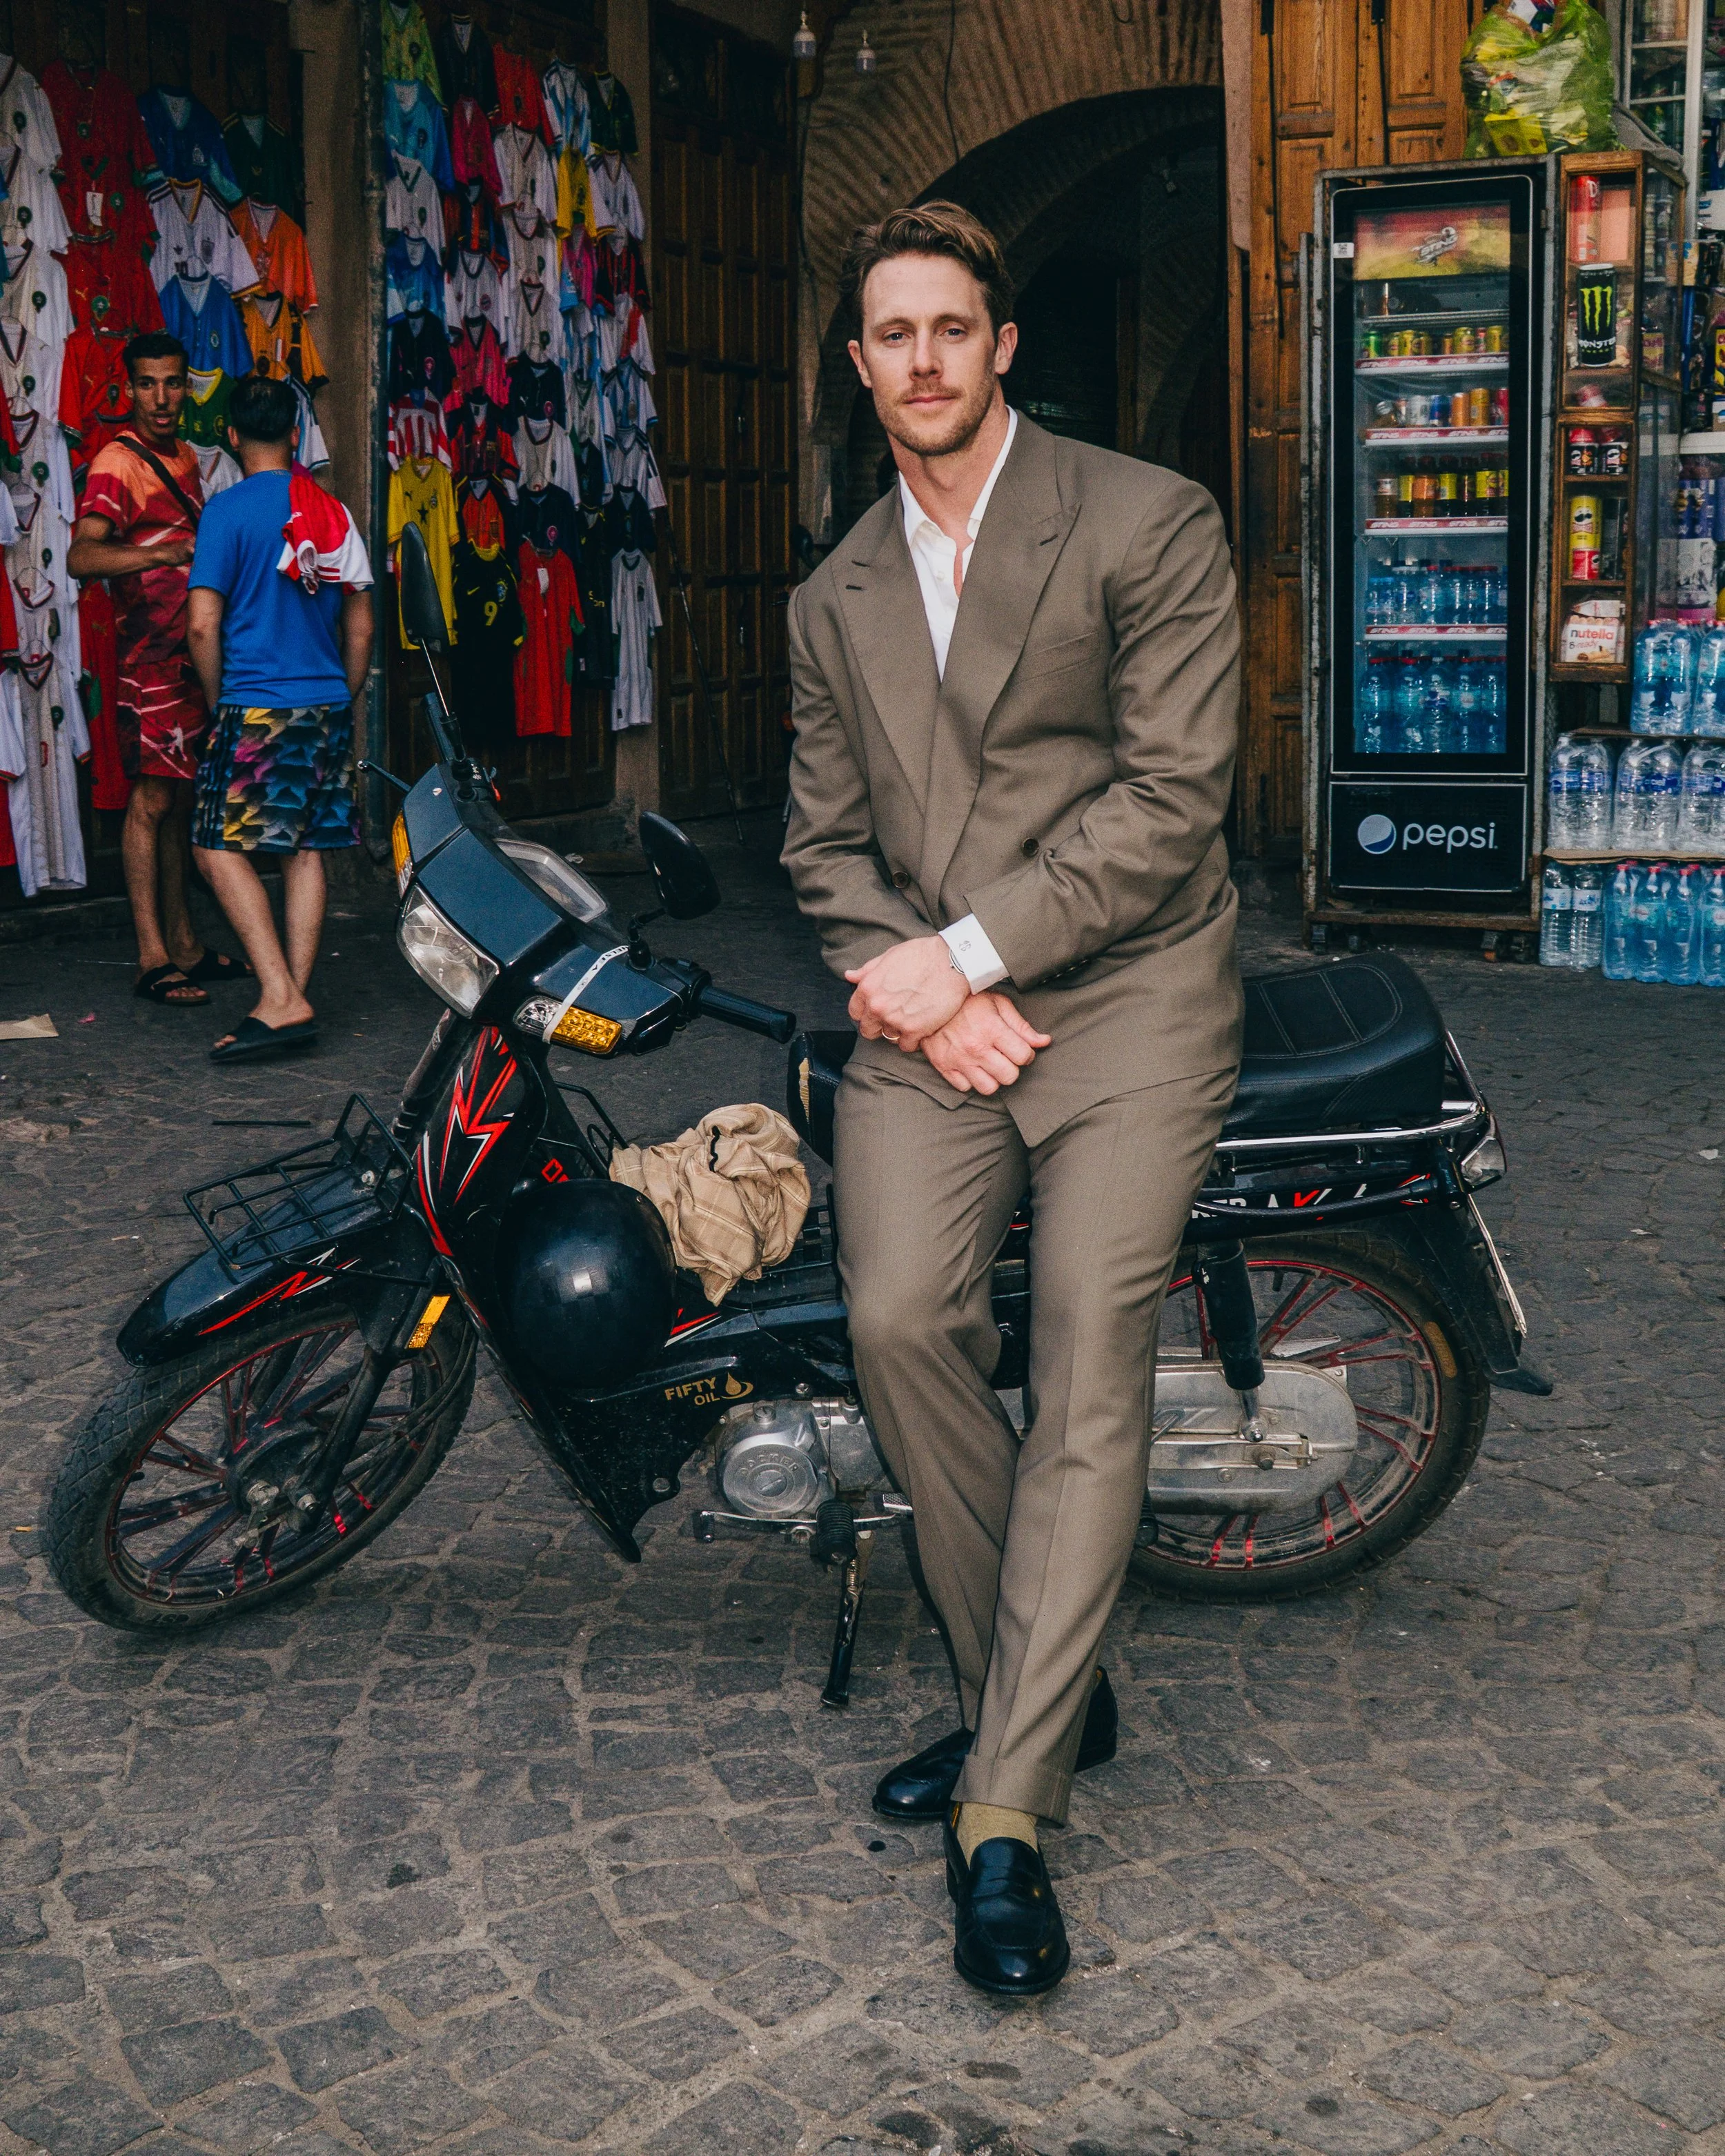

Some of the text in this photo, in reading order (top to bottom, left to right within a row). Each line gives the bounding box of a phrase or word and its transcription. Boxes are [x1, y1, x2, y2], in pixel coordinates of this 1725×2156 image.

[484, 601, 498, 626] 9
[1570, 629, 1615, 640] nutella
[1402, 822, 1495, 853] pepsi
[664, 1376, 716, 1401] FIFTY
[693, 1392, 720, 1406] OIL
